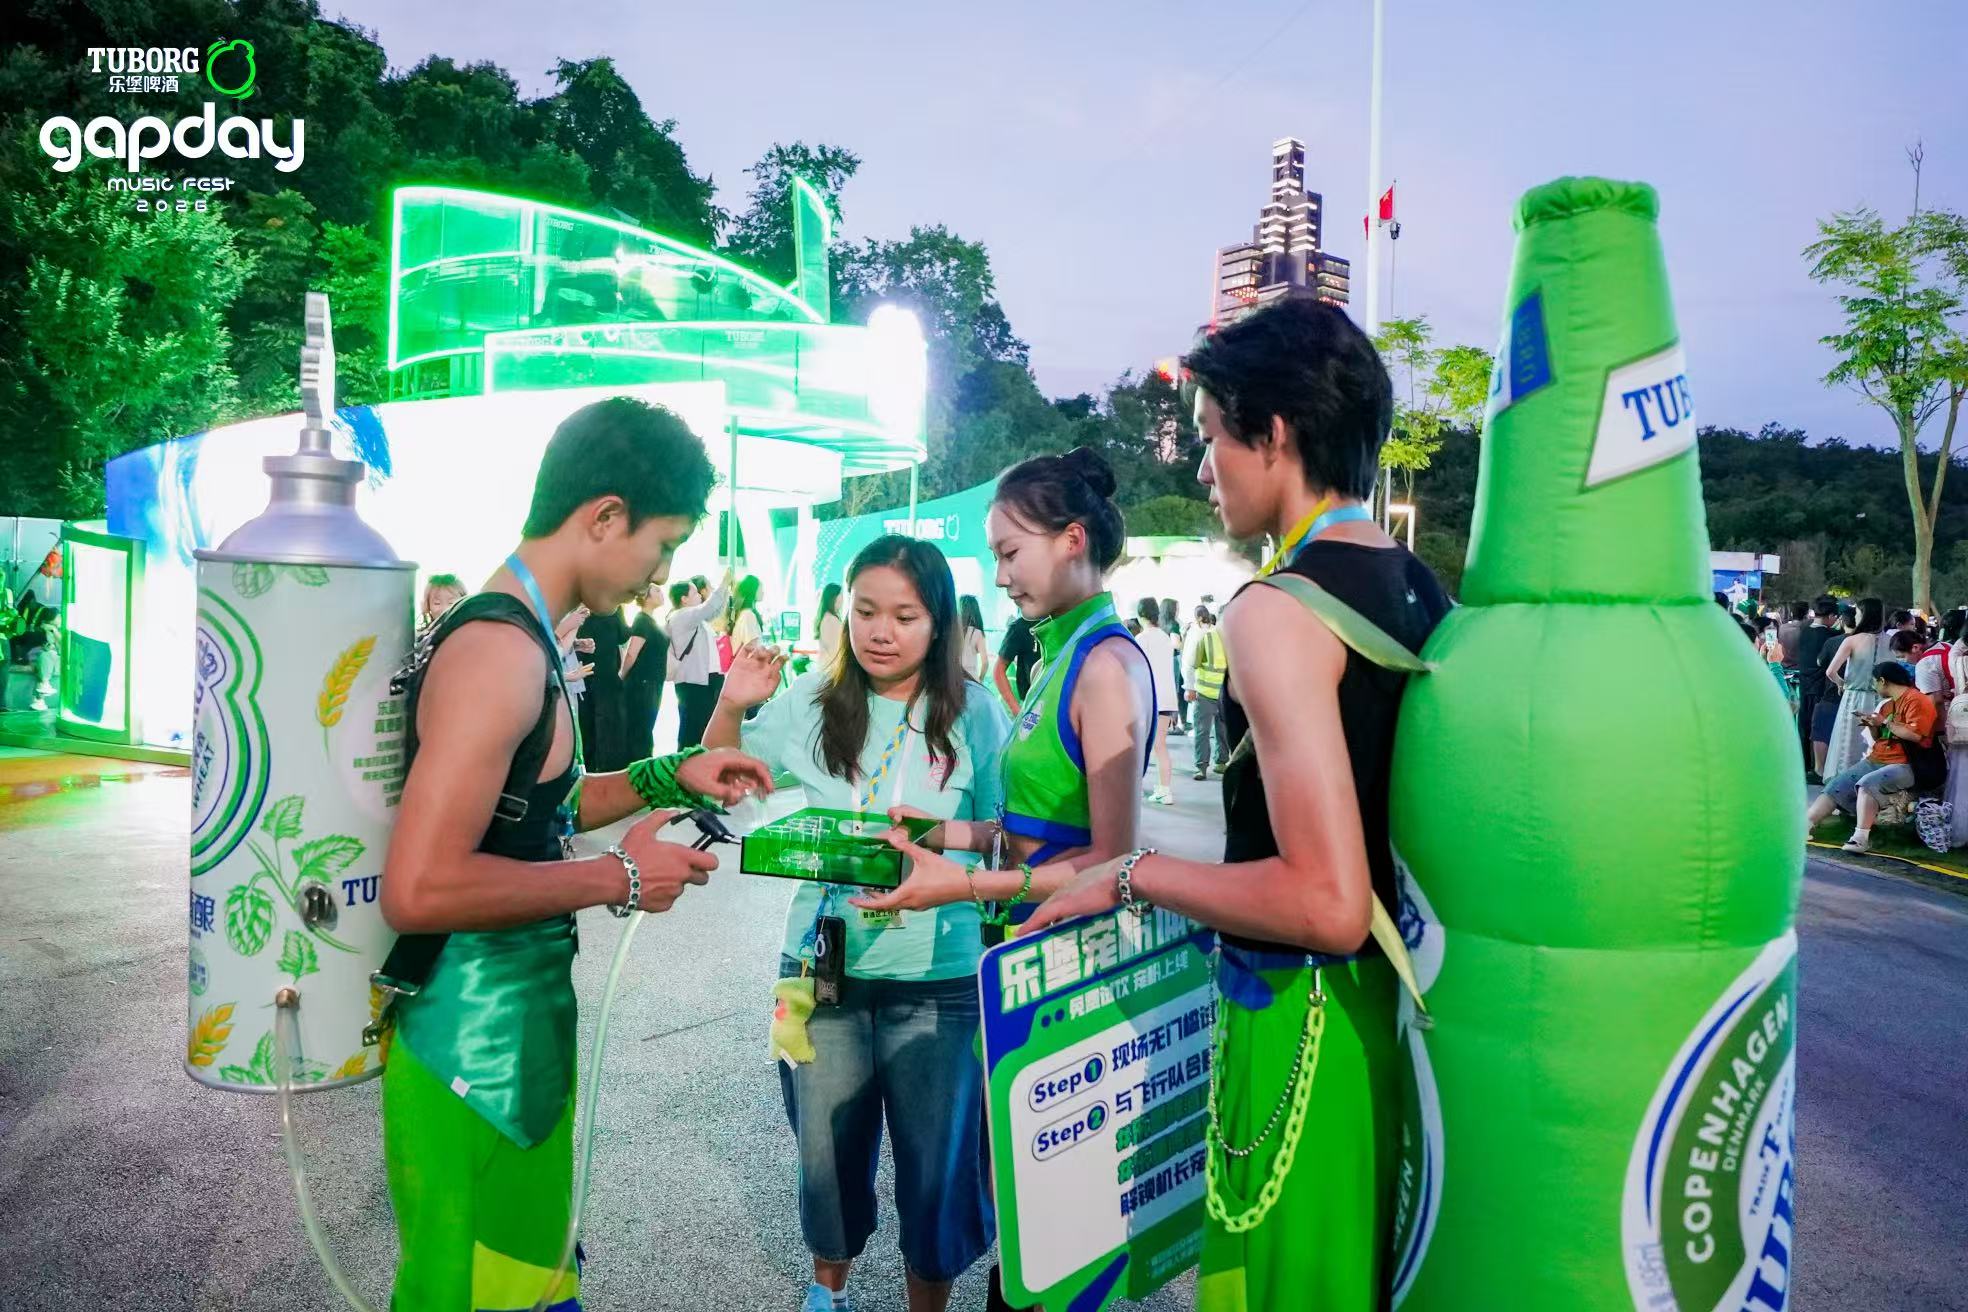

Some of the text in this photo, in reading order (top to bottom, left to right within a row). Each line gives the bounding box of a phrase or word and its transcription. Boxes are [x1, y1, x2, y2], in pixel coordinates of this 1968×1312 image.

[193, 742, 215, 809] WHEAT
[1001, 905, 1205, 1010] 乐堡宠粉
[1034, 1072, 1082, 1104] Step
[1682, 993, 1789, 1263] COPENHAGEN
[1721, 1077, 1764, 1172] DENMARK
[1037, 1120, 1085, 1153] Step
